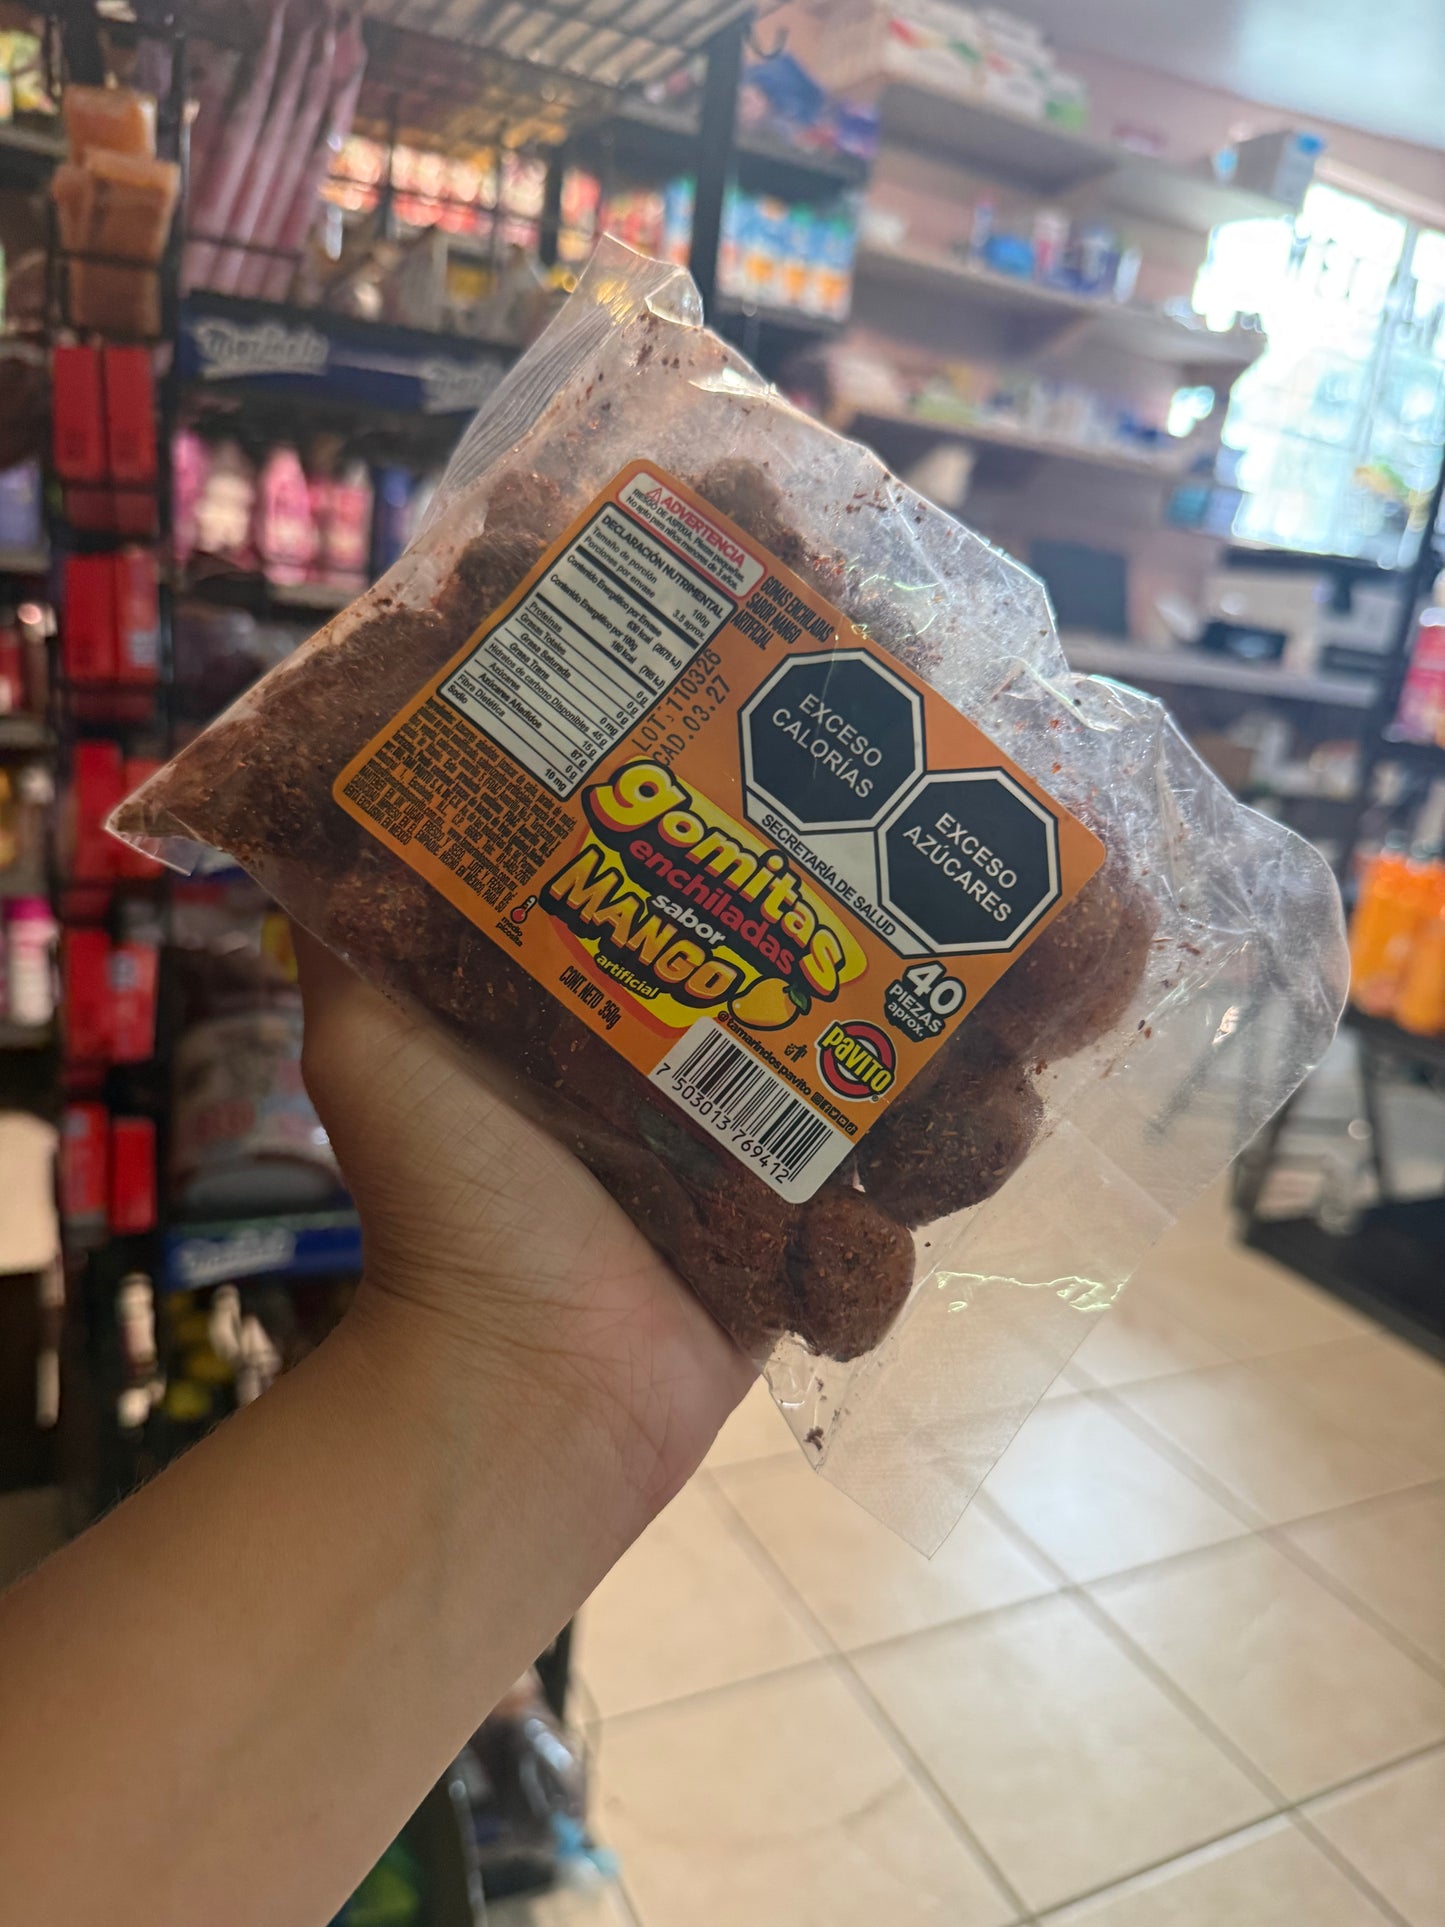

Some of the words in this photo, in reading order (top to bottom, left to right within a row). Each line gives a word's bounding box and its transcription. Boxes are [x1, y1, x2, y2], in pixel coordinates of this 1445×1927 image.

[631, 487, 659, 511] RIESGO
[654, 506, 669, 519] DE
[659, 493, 749, 568] ADVERTENCIA
[591, 526, 622, 554] Tamaño
[618, 548, 632, 561] de
[627, 556, 659, 584] porción
[689, 608, 711, 628] 100g
[600, 511, 668, 570] DECLARACIÓN
[661, 562, 726, 619] NUTRIMENTAL
[624, 494, 640, 508] No
[634, 503, 653, 520] apto
[648, 514, 667, 532] para
[662, 525, 684, 545] niños
[679, 539, 710, 566] menores
[705, 561, 719, 574] de
[713, 568, 723, 578] 3
[718, 572, 740, 591] años.
[548, 572, 583, 603] Contenido
[608, 625, 624, 640] por
[619, 633, 639, 652] 100g
[565, 553, 600, 584] Contenido
[625, 605, 641, 620] por
[636, 613, 664, 638] Envase
[582, 535, 620, 568] Porciones
[614, 563, 631, 579] por
[628, 573, 657, 599] envase
[670, 608, 686, 623] 3.5
[681, 618, 707, 642] aprox.
[743, 591, 779, 624] SABOR
[766, 610, 804, 645] MANGO
[757, 574, 795, 609] GOMAS
[782, 594, 837, 643] ENCHILADAS
[518, 612, 545, 636] Grasas
[519, 631, 543, 653] Grasa
[541, 631, 568, 656] Totales
[620, 649, 637, 664] kcal
[636, 629, 653, 645] kcal
[728, 607, 777, 651] ARTIFICIAL
[487, 641, 518, 670] Hidratos
[513, 664, 527, 677] de
[523, 672, 554, 701] carbono
[548, 696, 591, 734] Disponibles
[590, 728, 604, 741] 45
[598, 737, 608, 747] g
[507, 641, 532, 663] Grasa
[527, 658, 551, 680] Trans
[598, 716, 608, 725] 0
[603, 721, 619, 736] mg
[538, 648, 573, 679] Saturada
[634, 689, 644, 699] 0
[456, 673, 477, 692] Fibra
[473, 688, 506, 718] Dietética
[563, 764, 573, 773] 0
[568, 770, 578, 780] g
[477, 670, 512, 702] Azúcares
[507, 697, 544, 730] Añadidos
[577, 758, 588, 768] g
[488, 660, 522, 691] Azúcares
[580, 739, 593, 751] 15
[587, 748, 597, 758] g
[615, 710, 624, 719] 0
[619, 716, 629, 726] g
[625, 700, 634, 710] 0
[628, 706, 639, 716] g
[638, 696, 648, 706] g
[797, 692, 886, 770] EXCESO
[446, 683, 470, 705] Sodio
[542, 767, 556, 780] 10
[550, 776, 567, 792] mg
[767, 702, 879, 800] CALORÍAS
[589, 758, 854, 995] gomitas
[757, 811, 845, 889] SECRETARÍA
[835, 878, 858, 902] DE
[849, 893, 899, 939] SALUD
[898, 818, 1018, 924] AZÚCARES
[931, 811, 1022, 892] EXCESO
[494, 920, 525, 949] picosita
[499, 914, 525, 938] medio
[546, 848, 738, 1002] MANGO
[628, 834, 798, 974] enchiladas
[649, 892, 726, 949] sabor
[557, 964, 587, 994] CONT.
[576, 981, 605, 1010] NETO
[593, 998, 625, 1031] 350g
[595, 954, 658, 999] artificial
[886, 982, 944, 1035] PIEZAS
[899, 953, 971, 1021] 40
[714, 1008, 814, 1098] @tamarindospavito
[885, 999, 928, 1039] aprox.
[654, 1062, 671, 1079] 7
[670, 1075, 732, 1134] 503013
[730, 1128, 791, 1185] 769412
